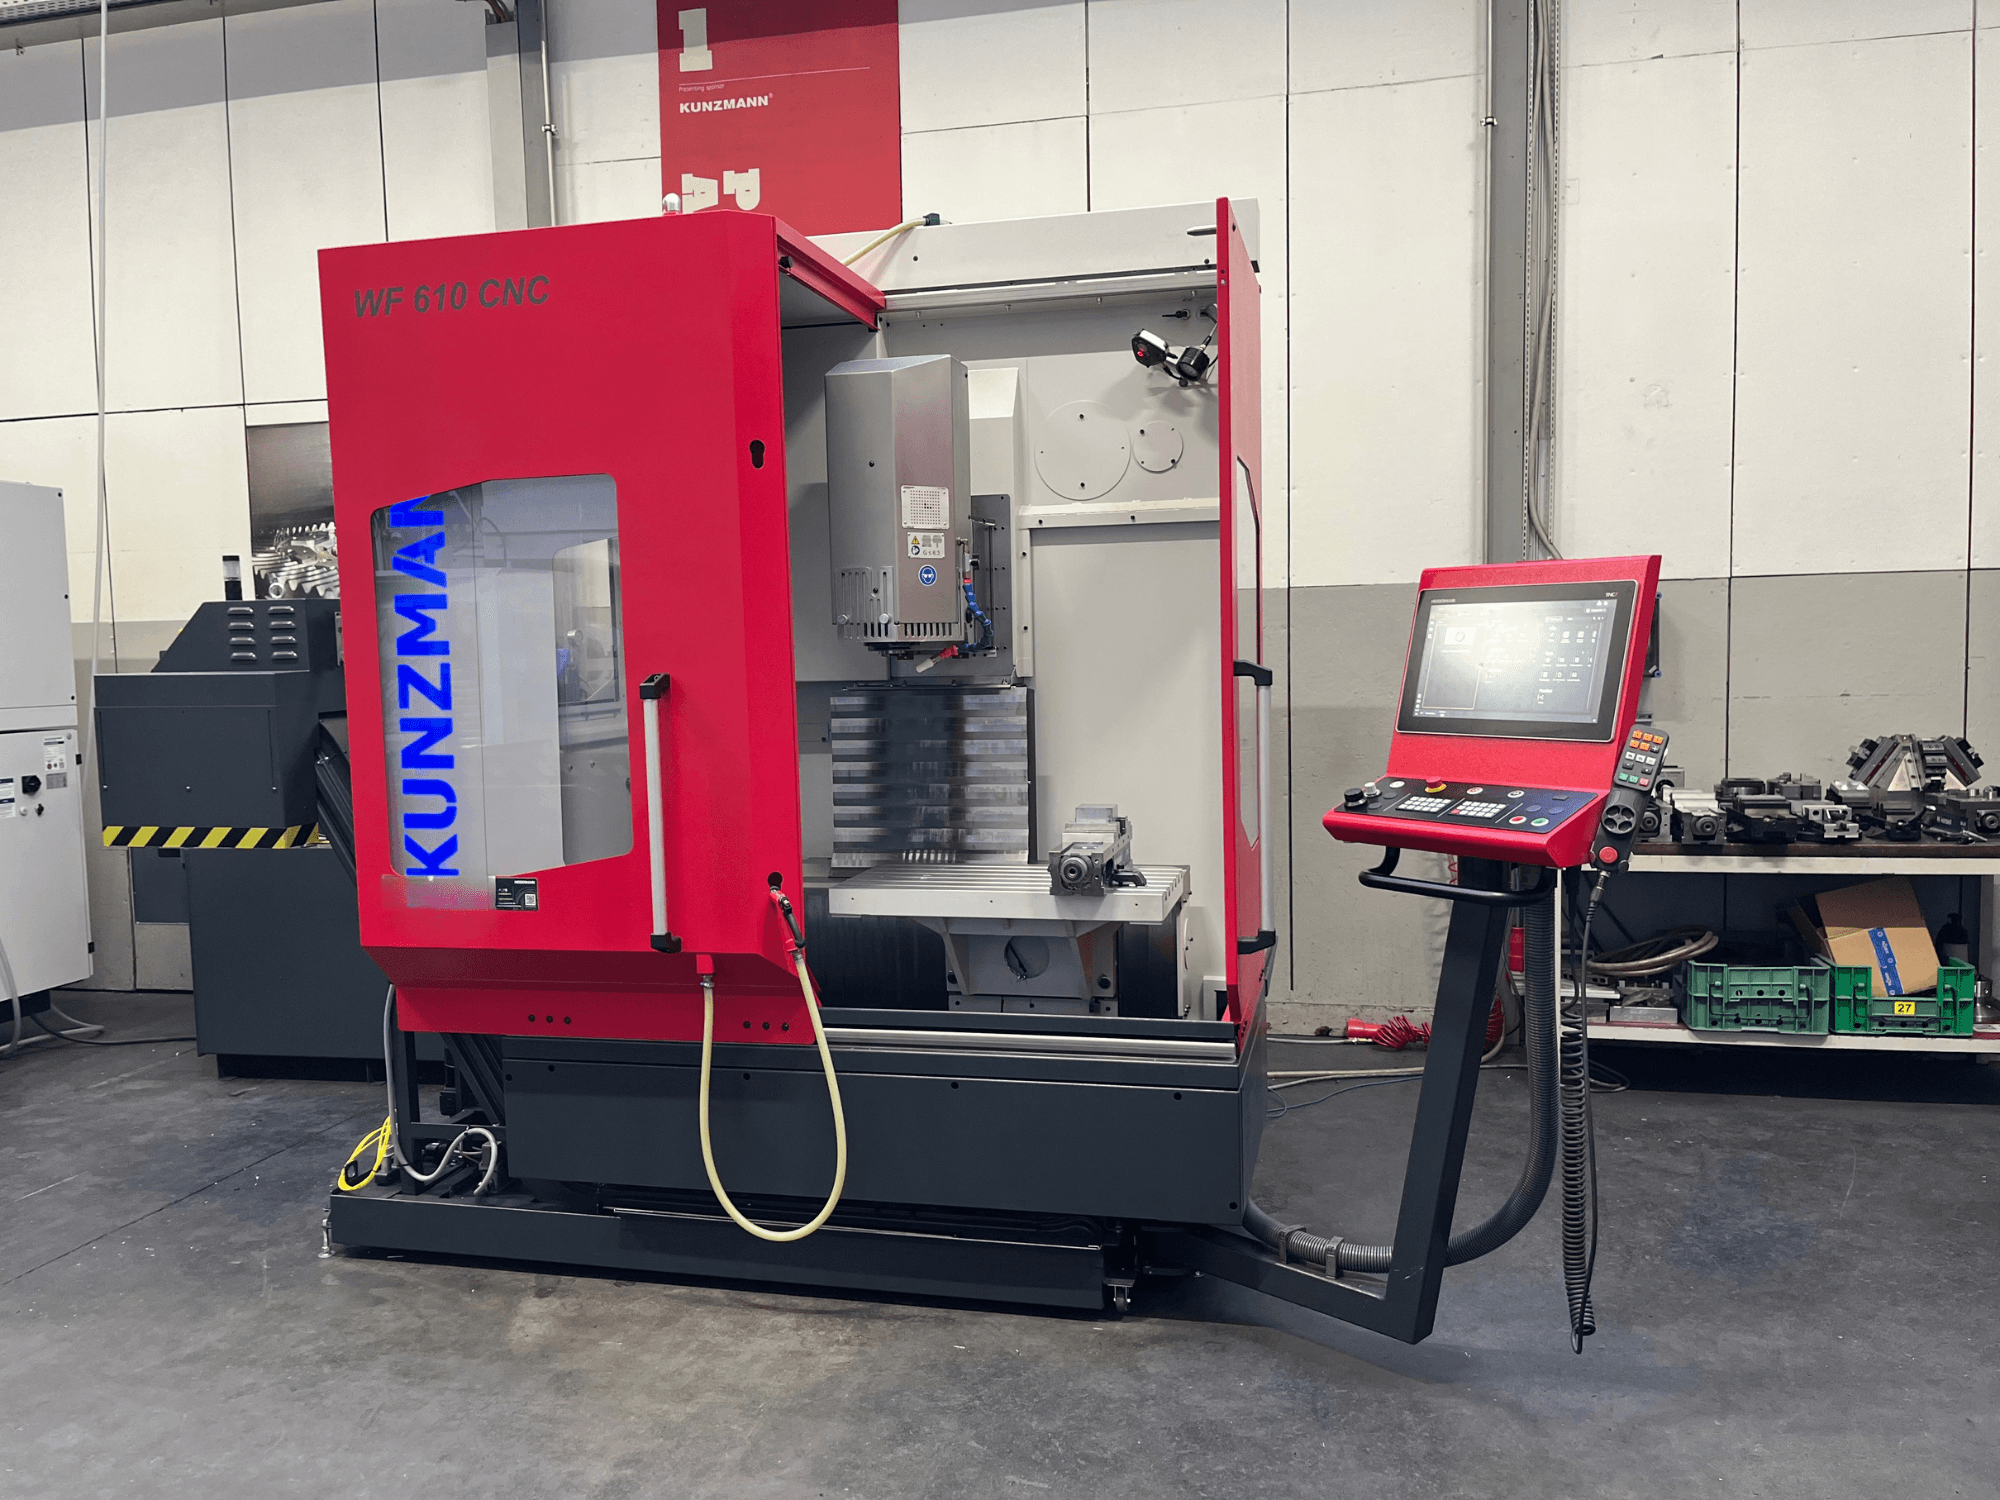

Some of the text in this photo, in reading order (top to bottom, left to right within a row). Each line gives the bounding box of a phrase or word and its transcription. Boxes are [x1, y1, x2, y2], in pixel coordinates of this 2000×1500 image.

[678, 8, 713, 72] 1
[354, 275, 550, 318] WF 610 CNC
[1897, 1003, 1913, 1013] 27
